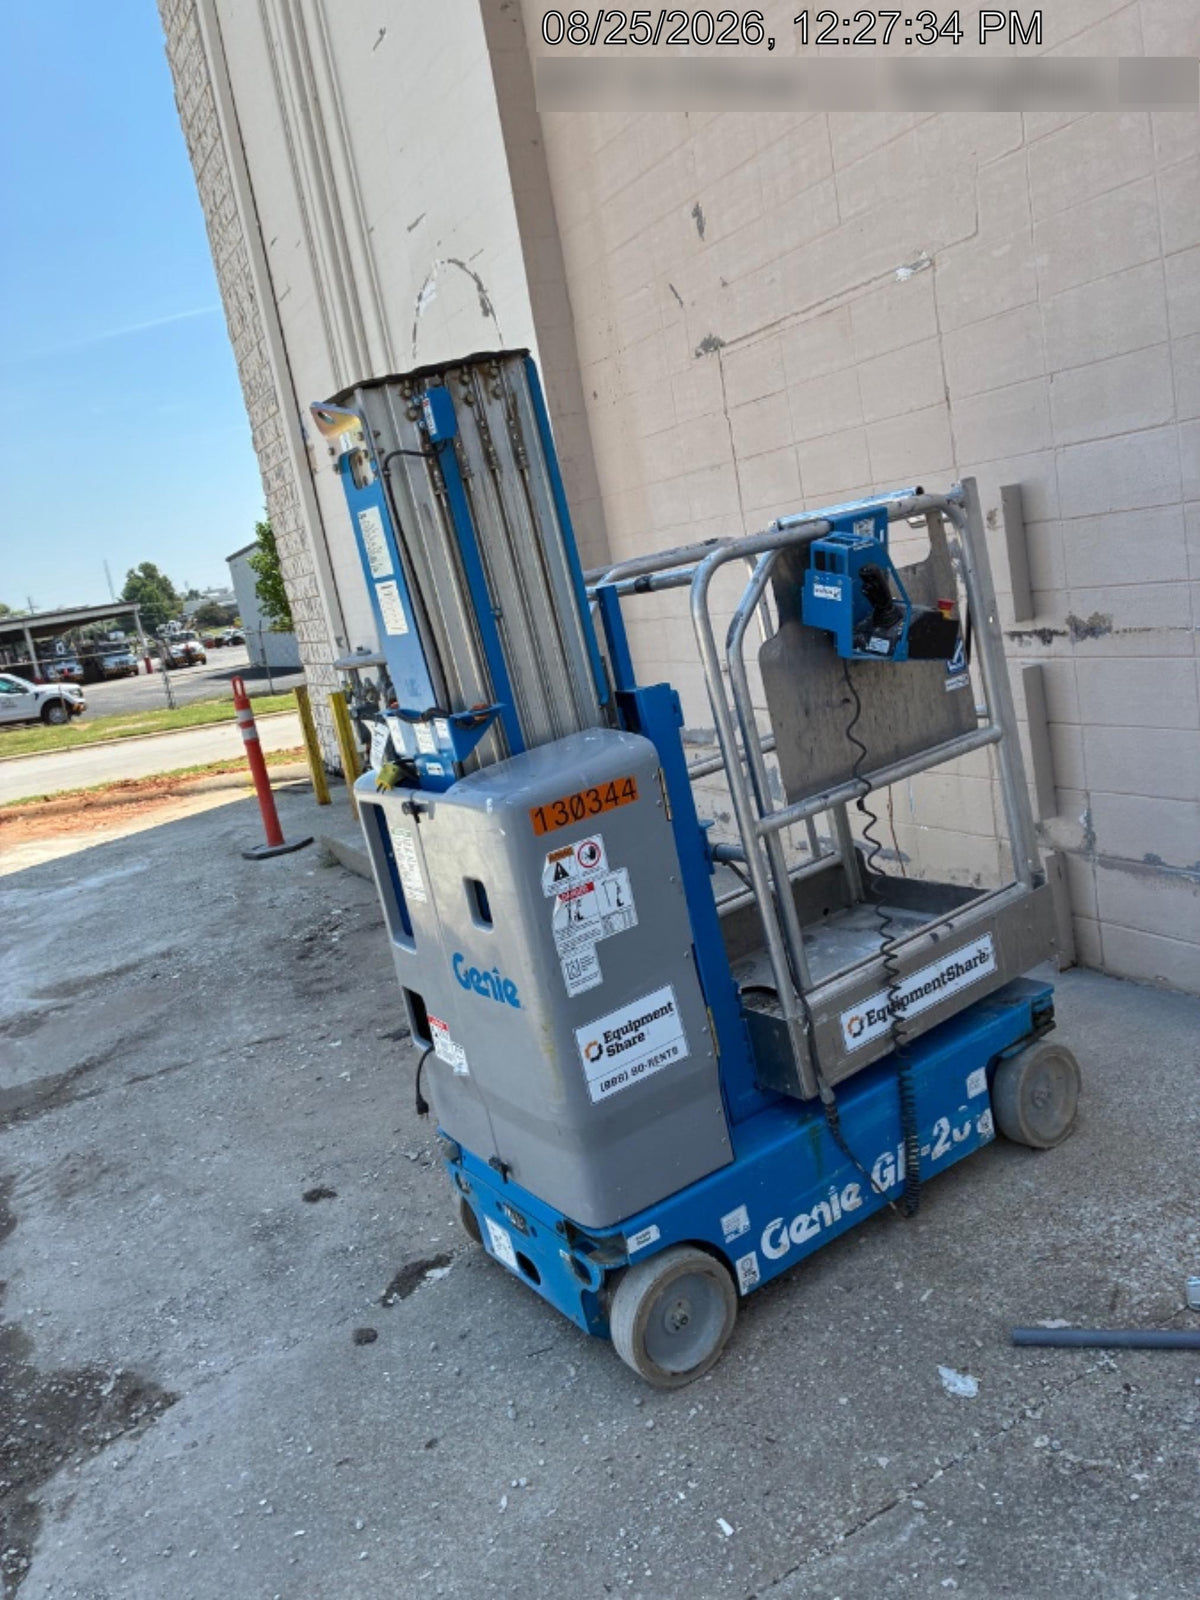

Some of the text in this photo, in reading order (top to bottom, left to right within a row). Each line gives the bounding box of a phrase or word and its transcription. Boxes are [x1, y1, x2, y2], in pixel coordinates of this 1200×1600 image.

[534, 778, 637, 832] 130344
[453, 952, 521, 1008] Genie
[602, 1001, 674, 1043] Equipment
[605, 1031, 646, 1057] Share
[760, 1183, 863, 1260] Genie
